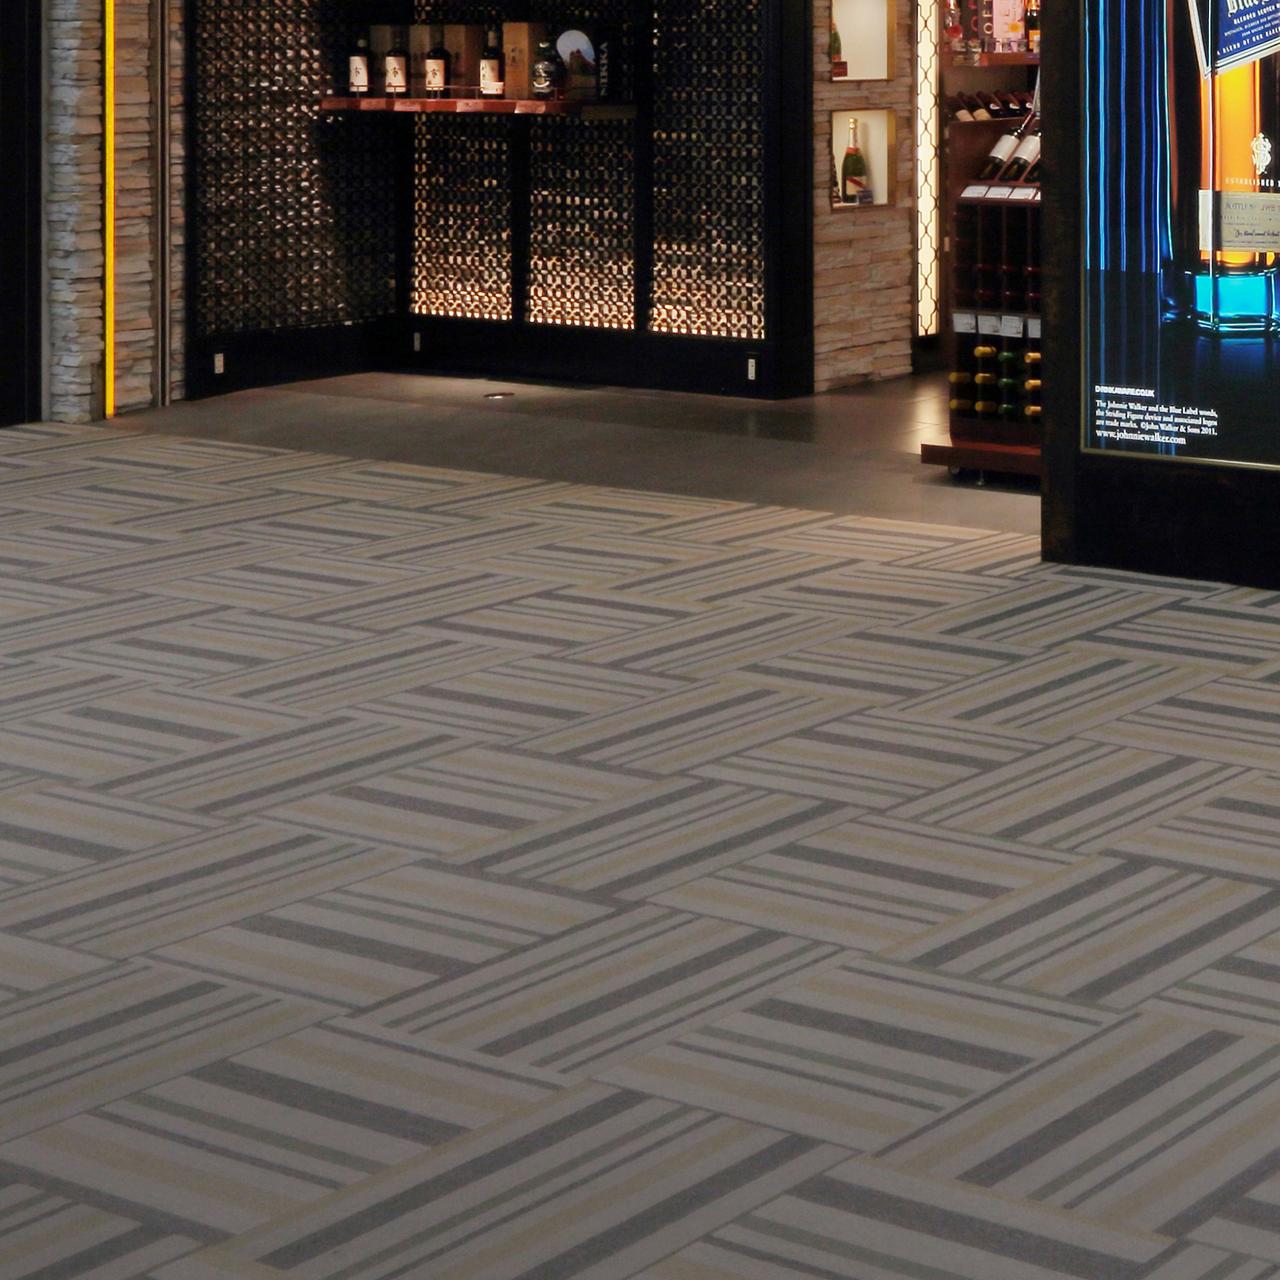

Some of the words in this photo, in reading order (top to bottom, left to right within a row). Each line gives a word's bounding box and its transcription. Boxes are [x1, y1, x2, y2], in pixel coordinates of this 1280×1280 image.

[1107, 401, 1127, 410] Johnnie
[1128, 402, 1147, 411] Walker
[1159, 405, 1168, 413] the
[1182, 407, 1198, 415] Label
[1159, 423, 1179, 432] Walker
[1095, 429, 1187, 445] www.johnniewalker.com
